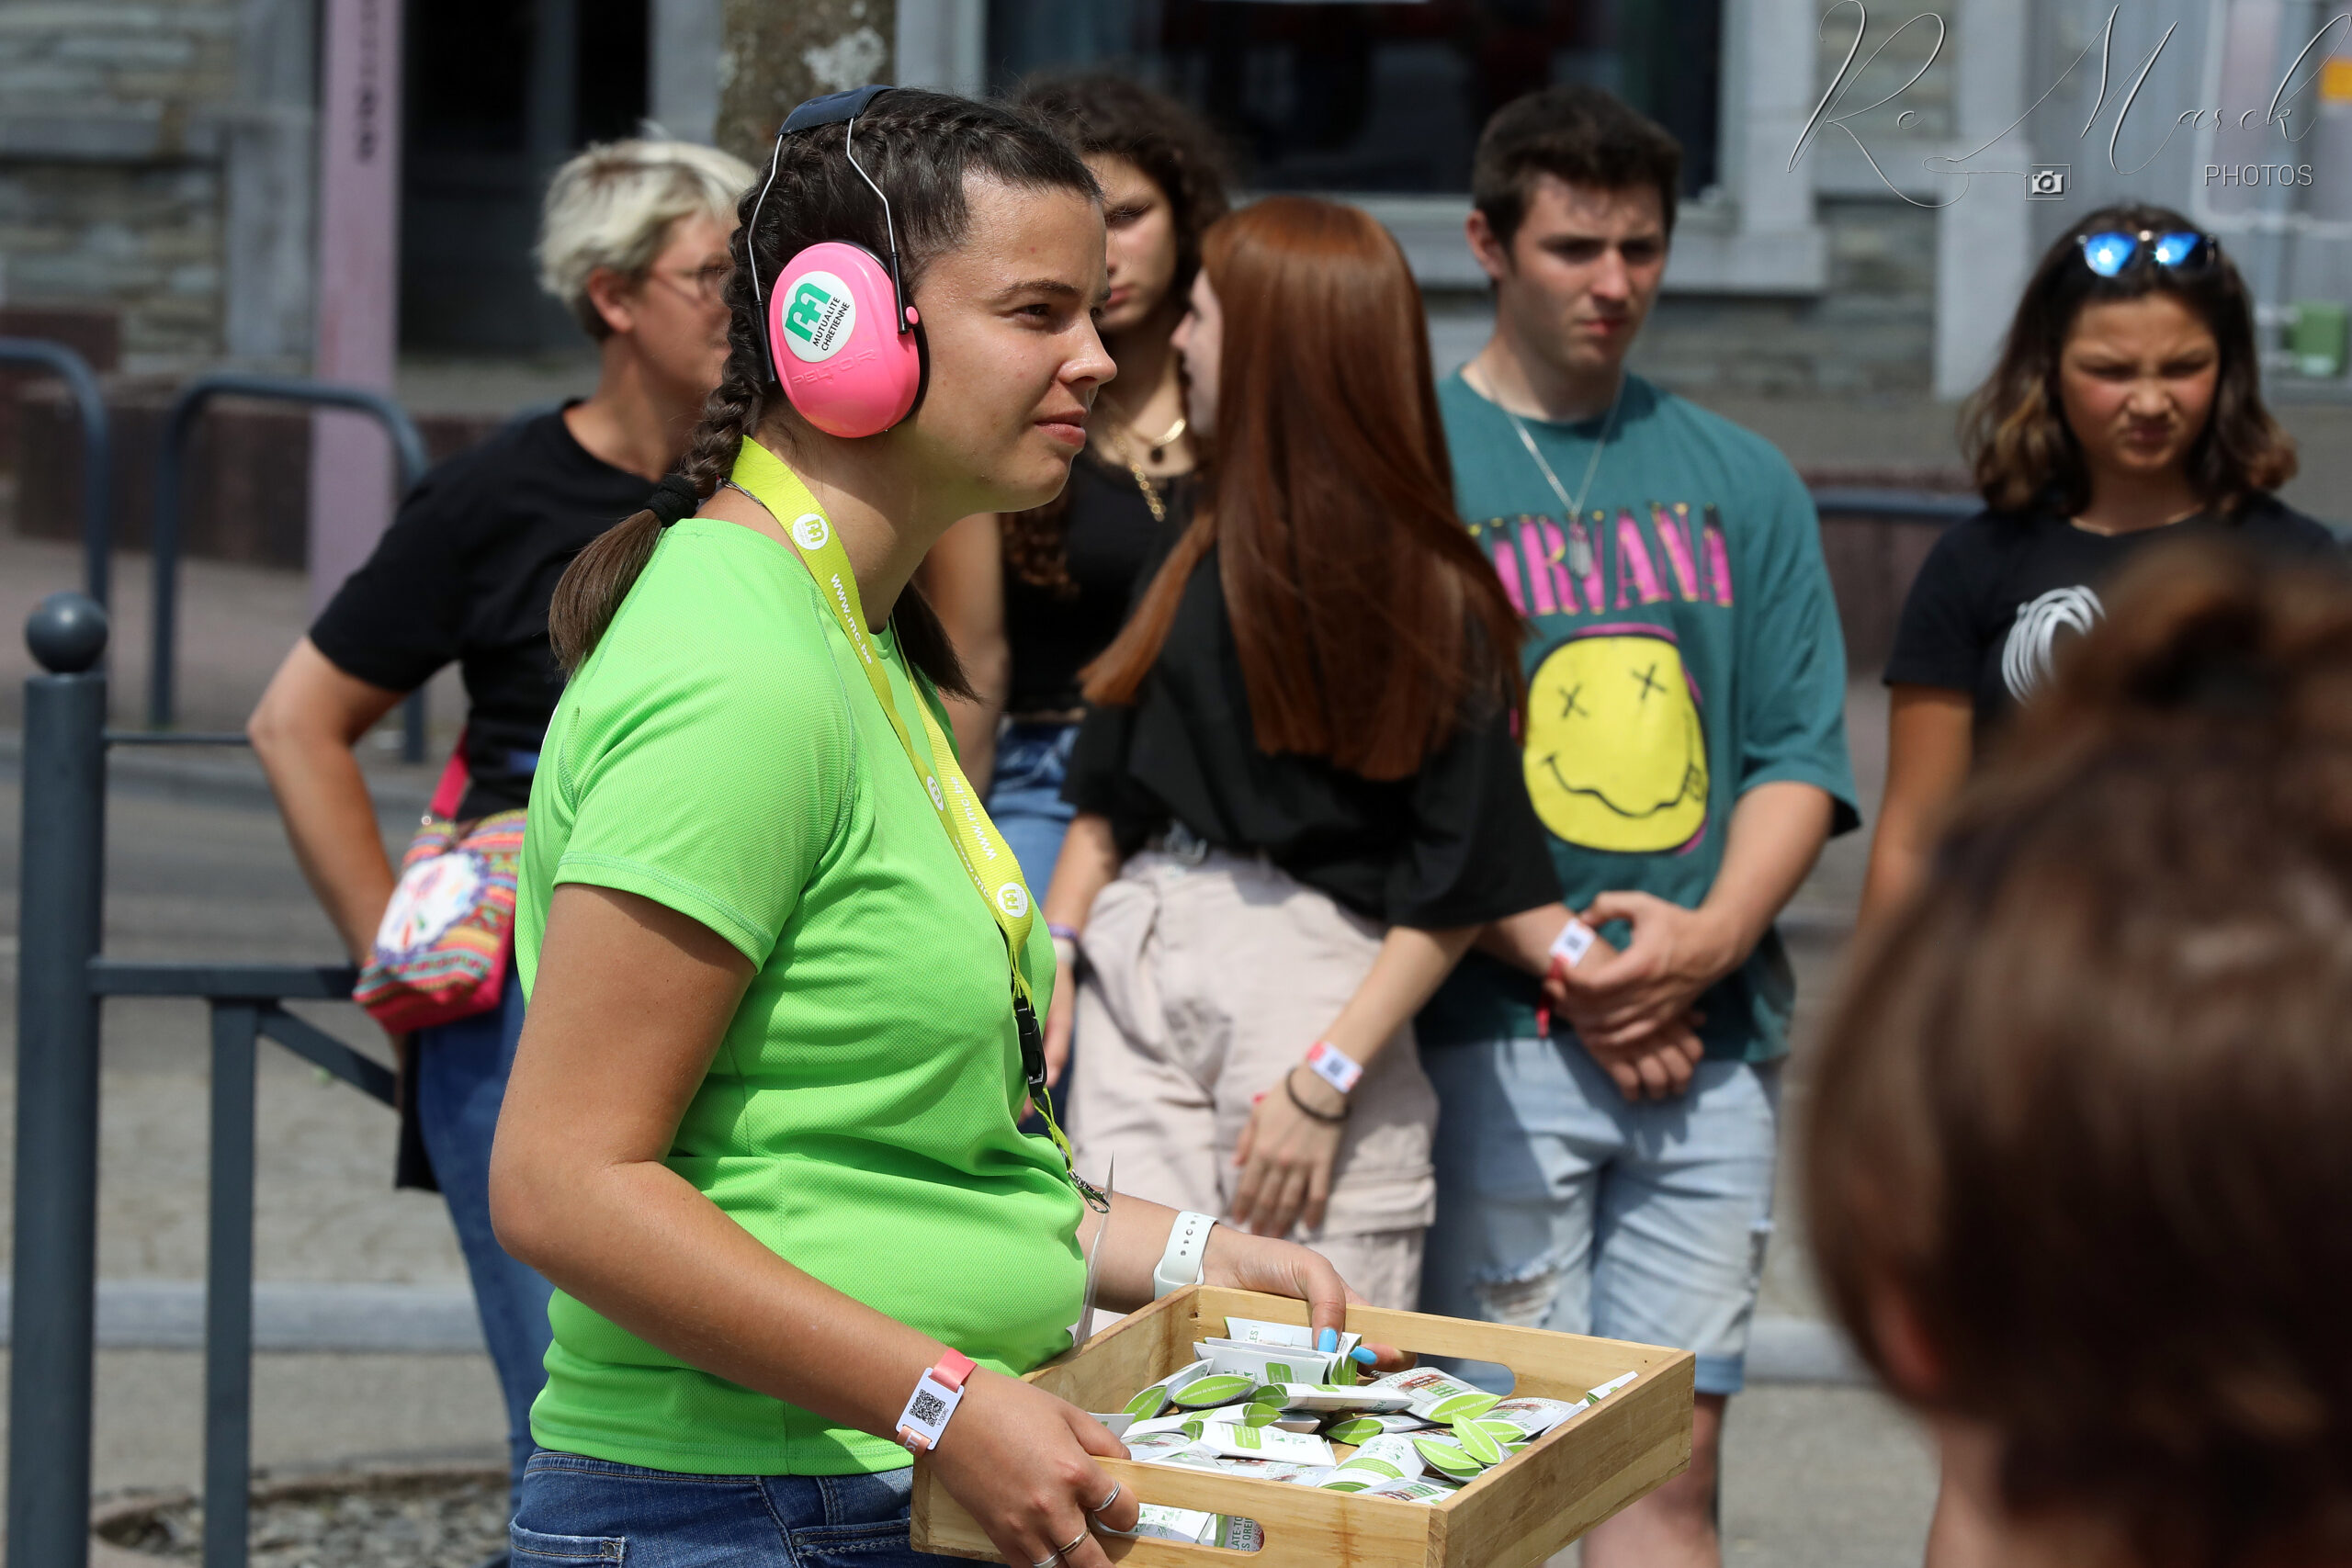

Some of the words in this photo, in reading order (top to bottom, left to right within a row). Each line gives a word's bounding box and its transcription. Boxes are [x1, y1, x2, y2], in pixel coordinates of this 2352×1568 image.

[812, 297, 841, 346] MUTUALITE
[820, 302, 850, 351] CHRETIENNE
[1468, 502, 1734, 616] IRVANA
[831, 572, 872, 665] www.mc.be
[950, 776, 998, 861] www.mc.be
